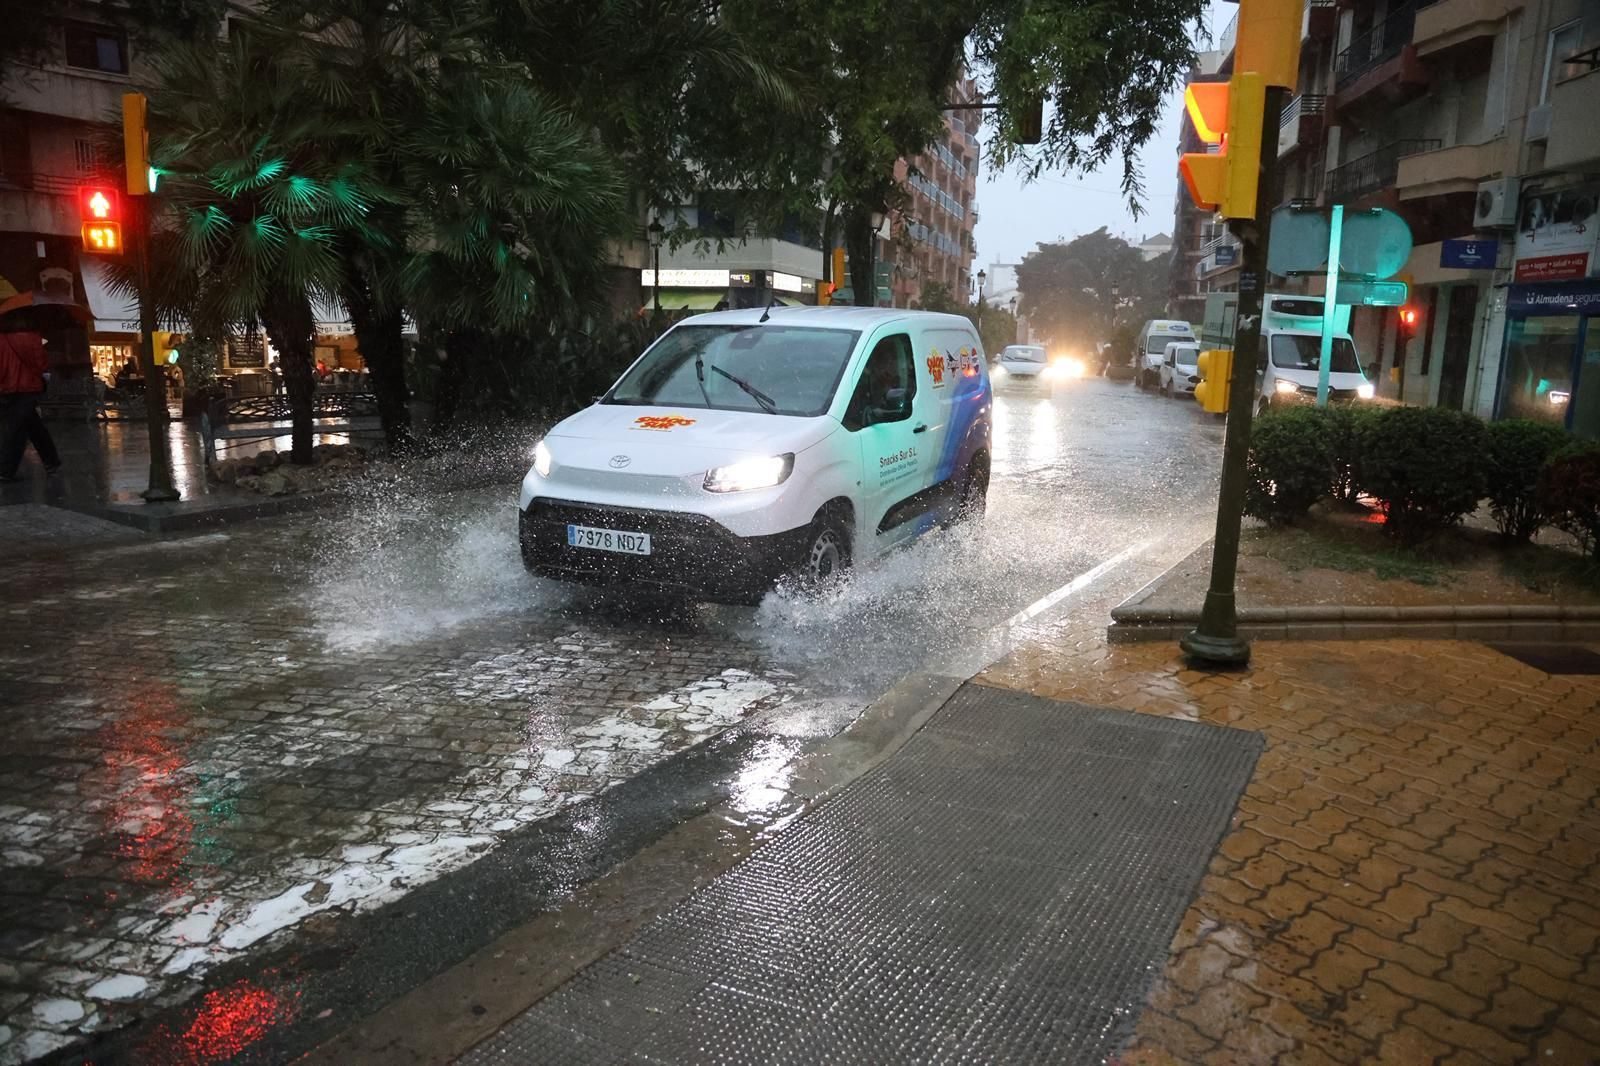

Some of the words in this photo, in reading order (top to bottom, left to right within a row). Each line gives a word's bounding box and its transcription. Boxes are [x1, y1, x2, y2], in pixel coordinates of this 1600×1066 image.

[1535, 292, 1574, 304] Almudena
[880, 452, 898, 468] Snacks
[900, 450, 909, 461] Sur
[617, 534, 645, 552] NDZ
